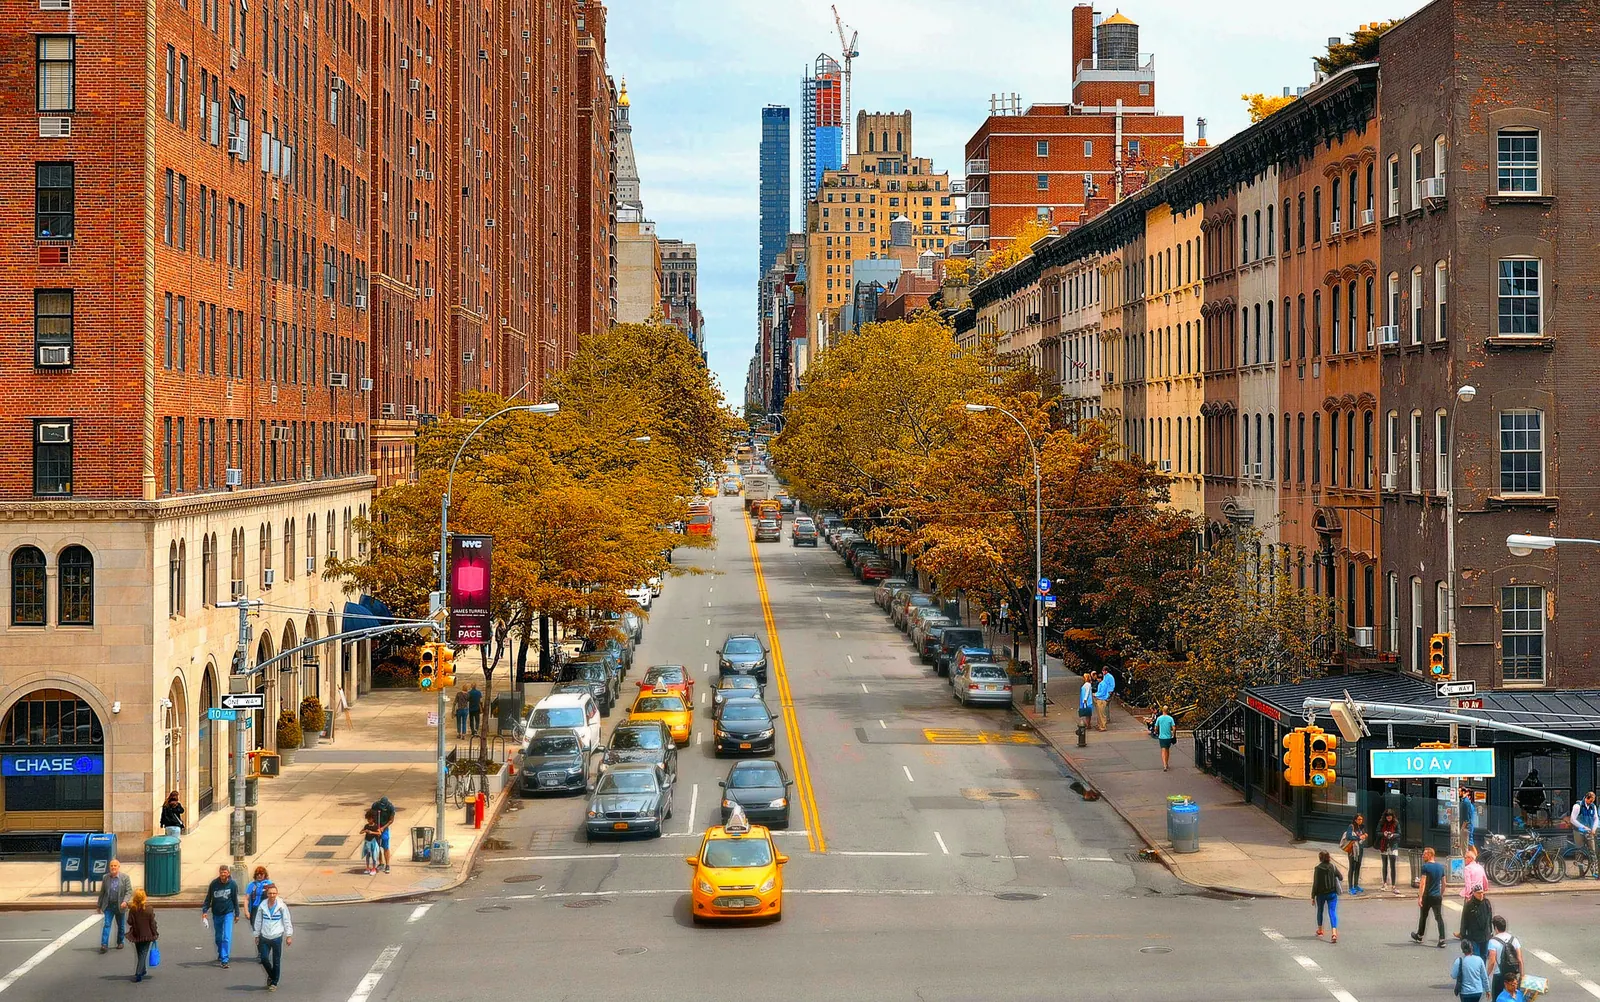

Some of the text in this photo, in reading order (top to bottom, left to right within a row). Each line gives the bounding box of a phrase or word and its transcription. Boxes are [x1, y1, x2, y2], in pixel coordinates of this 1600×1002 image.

[461, 540, 482, 548] NYC
[458, 630, 482, 638] PACE
[1462, 700, 1470, 709] 10
[211, 709, 221, 719] 10
[15, 758, 74, 772] CHASE
[1406, 756, 1452, 770] 10 Av
